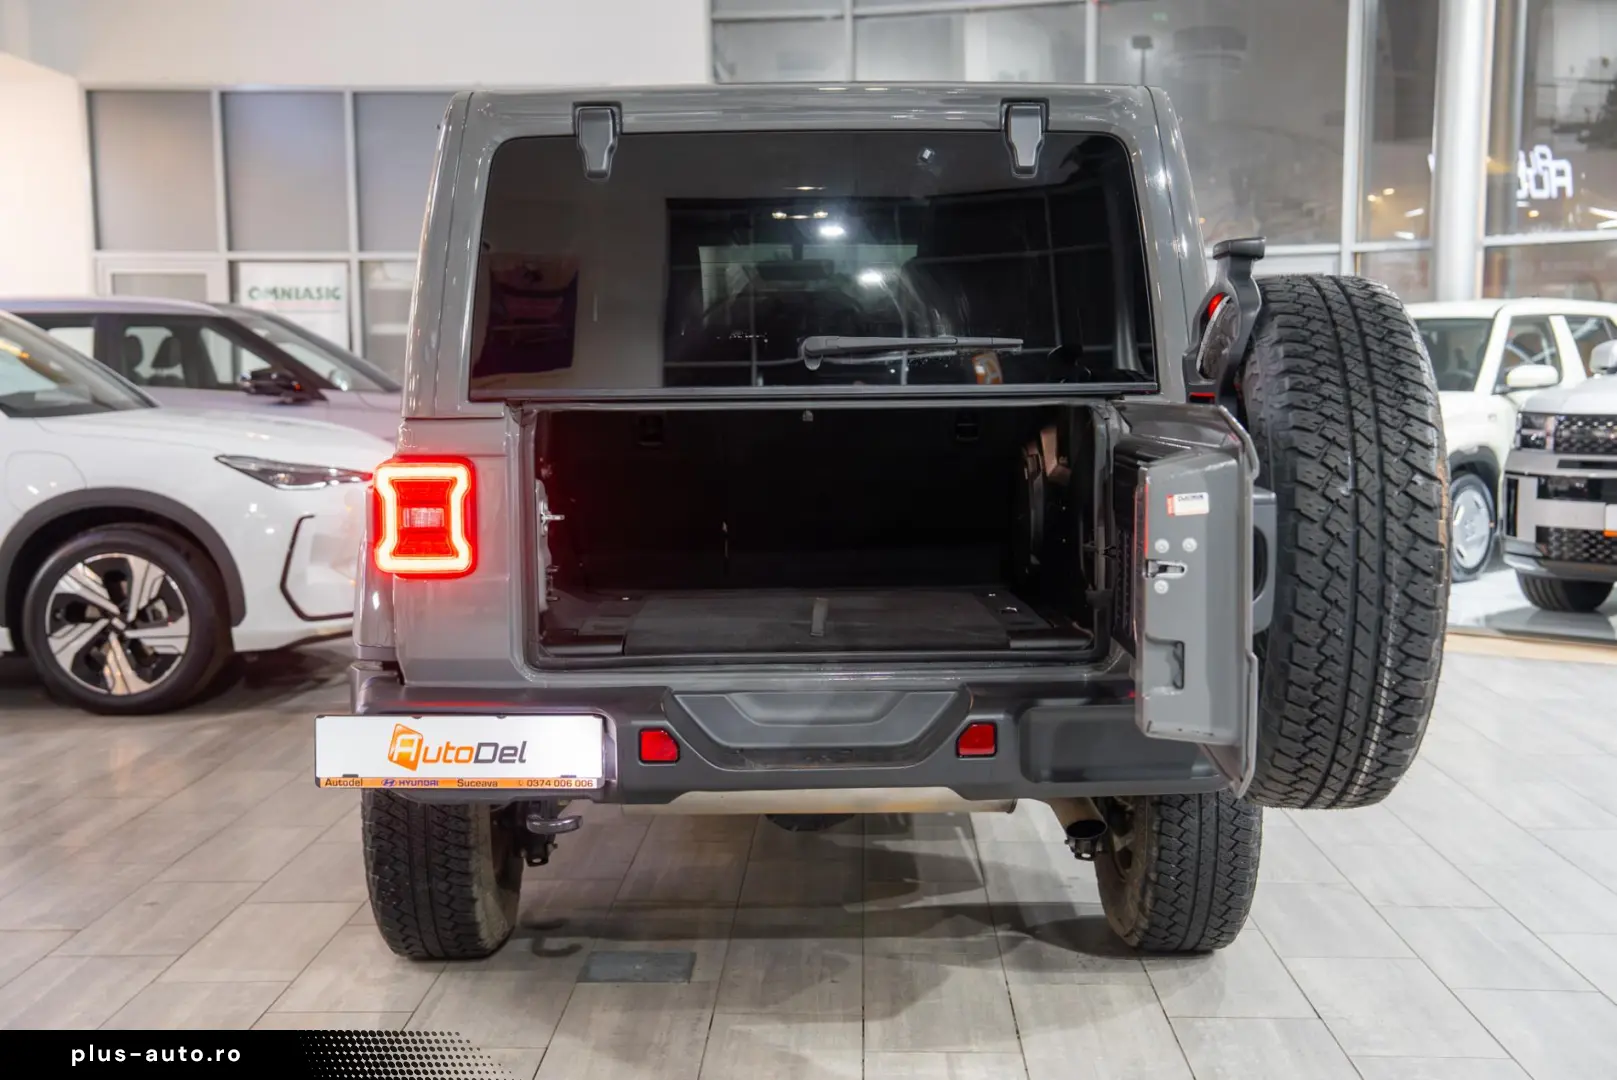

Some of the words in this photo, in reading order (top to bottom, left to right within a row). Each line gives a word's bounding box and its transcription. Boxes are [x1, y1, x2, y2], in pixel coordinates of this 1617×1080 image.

[388, 723, 527, 771] AutoDel
[324, 778, 363, 788] Autodel
[398, 779, 439, 787] HYUNDAI
[456, 779, 498, 788] Suceava
[526, 780, 552, 788] 0374
[554, 780, 572, 788] 006
[575, 780, 594, 788] 006
